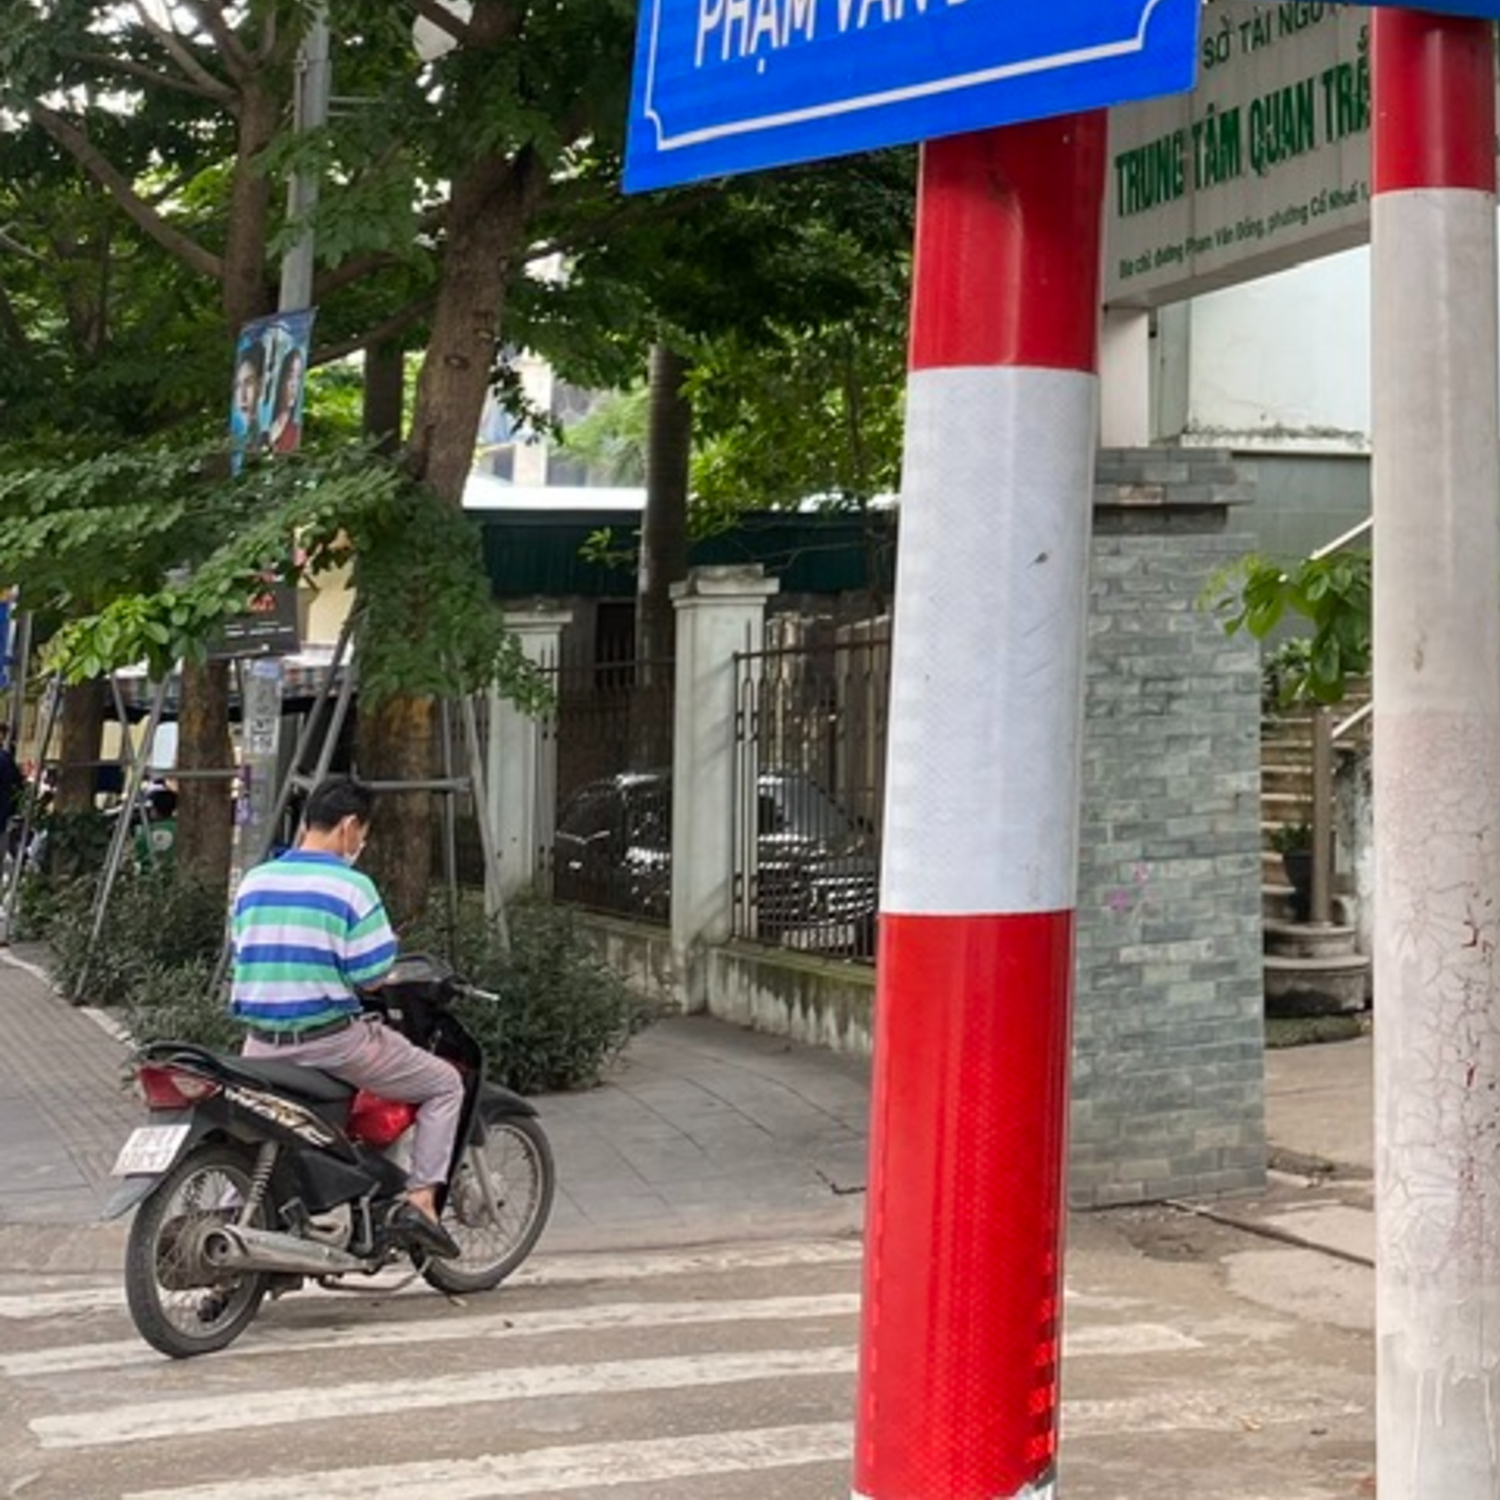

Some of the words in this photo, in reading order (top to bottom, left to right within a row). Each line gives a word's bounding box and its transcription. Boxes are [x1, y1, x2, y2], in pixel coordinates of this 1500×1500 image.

[1238, 4, 1271, 53] TÀI
[1115, 127, 1185, 218] TRUNG
[1192, 102, 1242, 191] TÂM
[1249, 77, 1316, 177] QUAN
